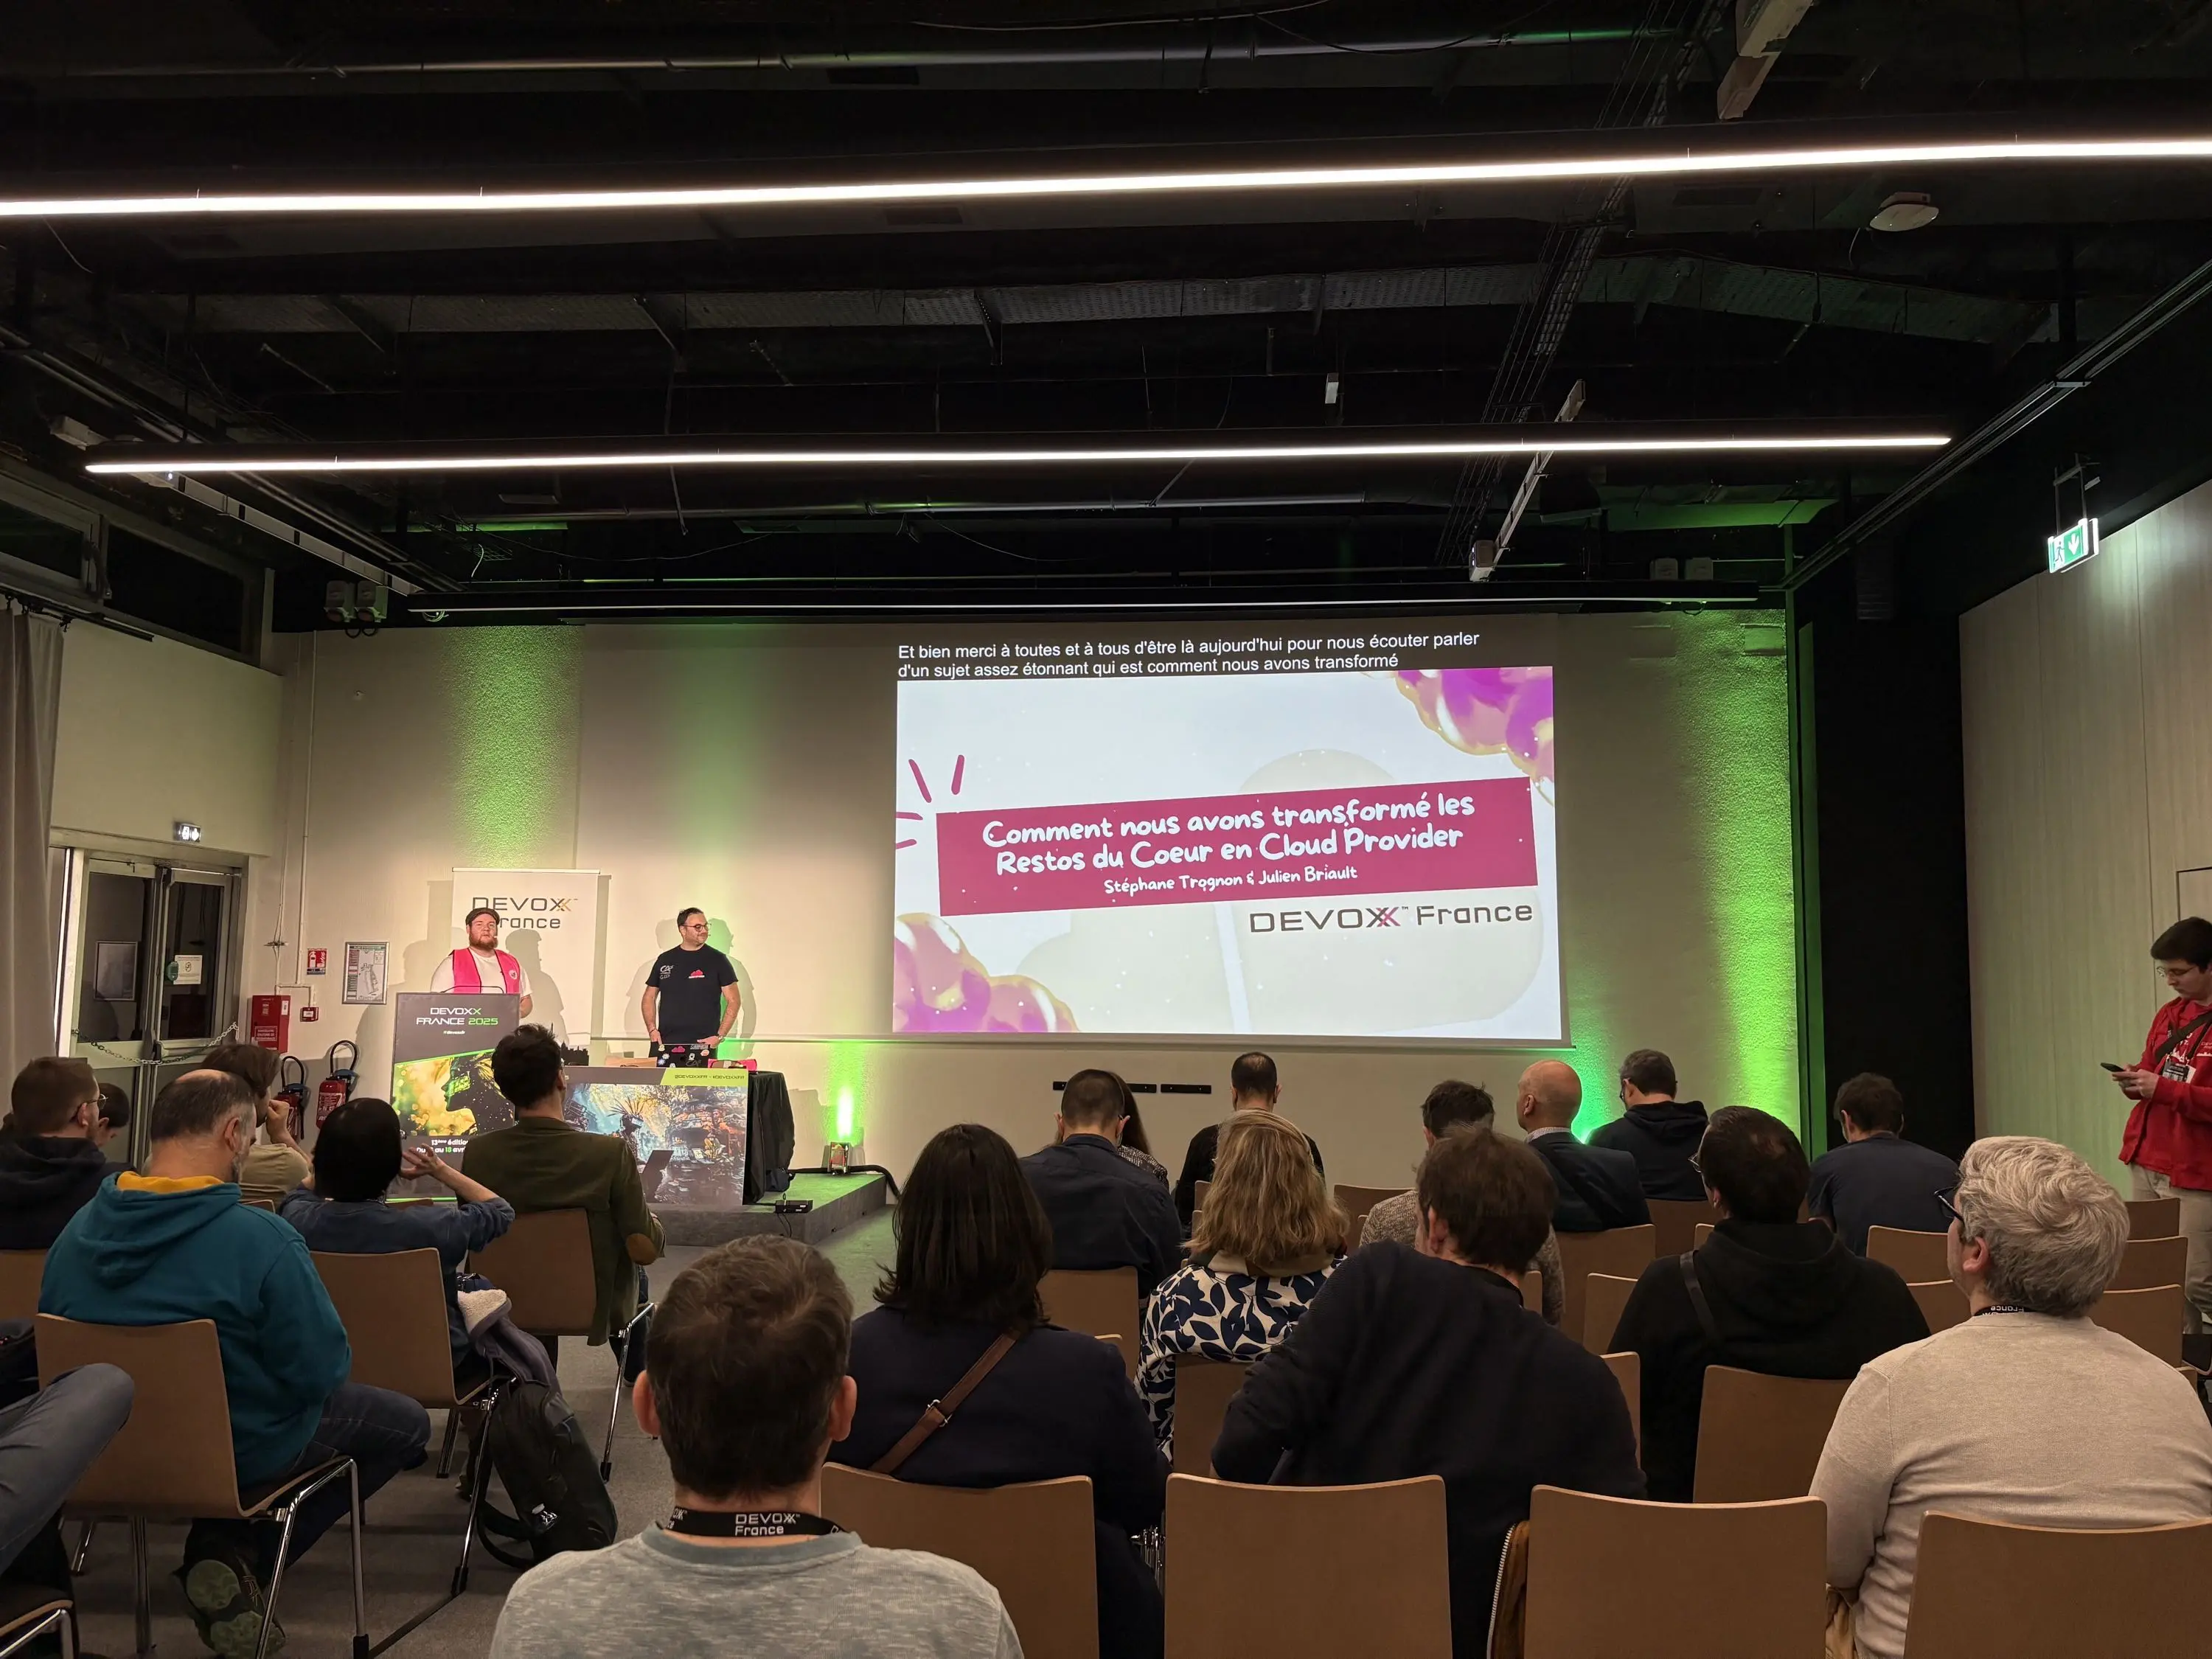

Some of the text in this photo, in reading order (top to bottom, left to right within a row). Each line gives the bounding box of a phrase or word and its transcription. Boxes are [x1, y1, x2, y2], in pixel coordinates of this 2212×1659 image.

[898, 632, 1480, 659] Et bien merci à toutes et à tous d'être là aujourd'hui pour nous écouter parler
[898, 653, 1398, 679] d'un sujet assez étonnant qui est comment nous avons transformé
[983, 792, 1475, 847] Comment nous avons transformé les
[996, 821, 1463, 875] Restos du Coeur en Cloud Provider
[1104, 876, 1175, 897] Stéphane
[1179, 874, 1242, 892] Trognon
[1258, 869, 1301, 885] Julien
[1304, 865, 1357, 882] Briault
[500, 917, 561, 928] rance
[1417, 905, 1532, 925] France
[417, 1018, 499, 1026] FRANCE 2025
[430, 1007, 482, 1015] DEVOXX
[735, 1525, 784, 1536] France
